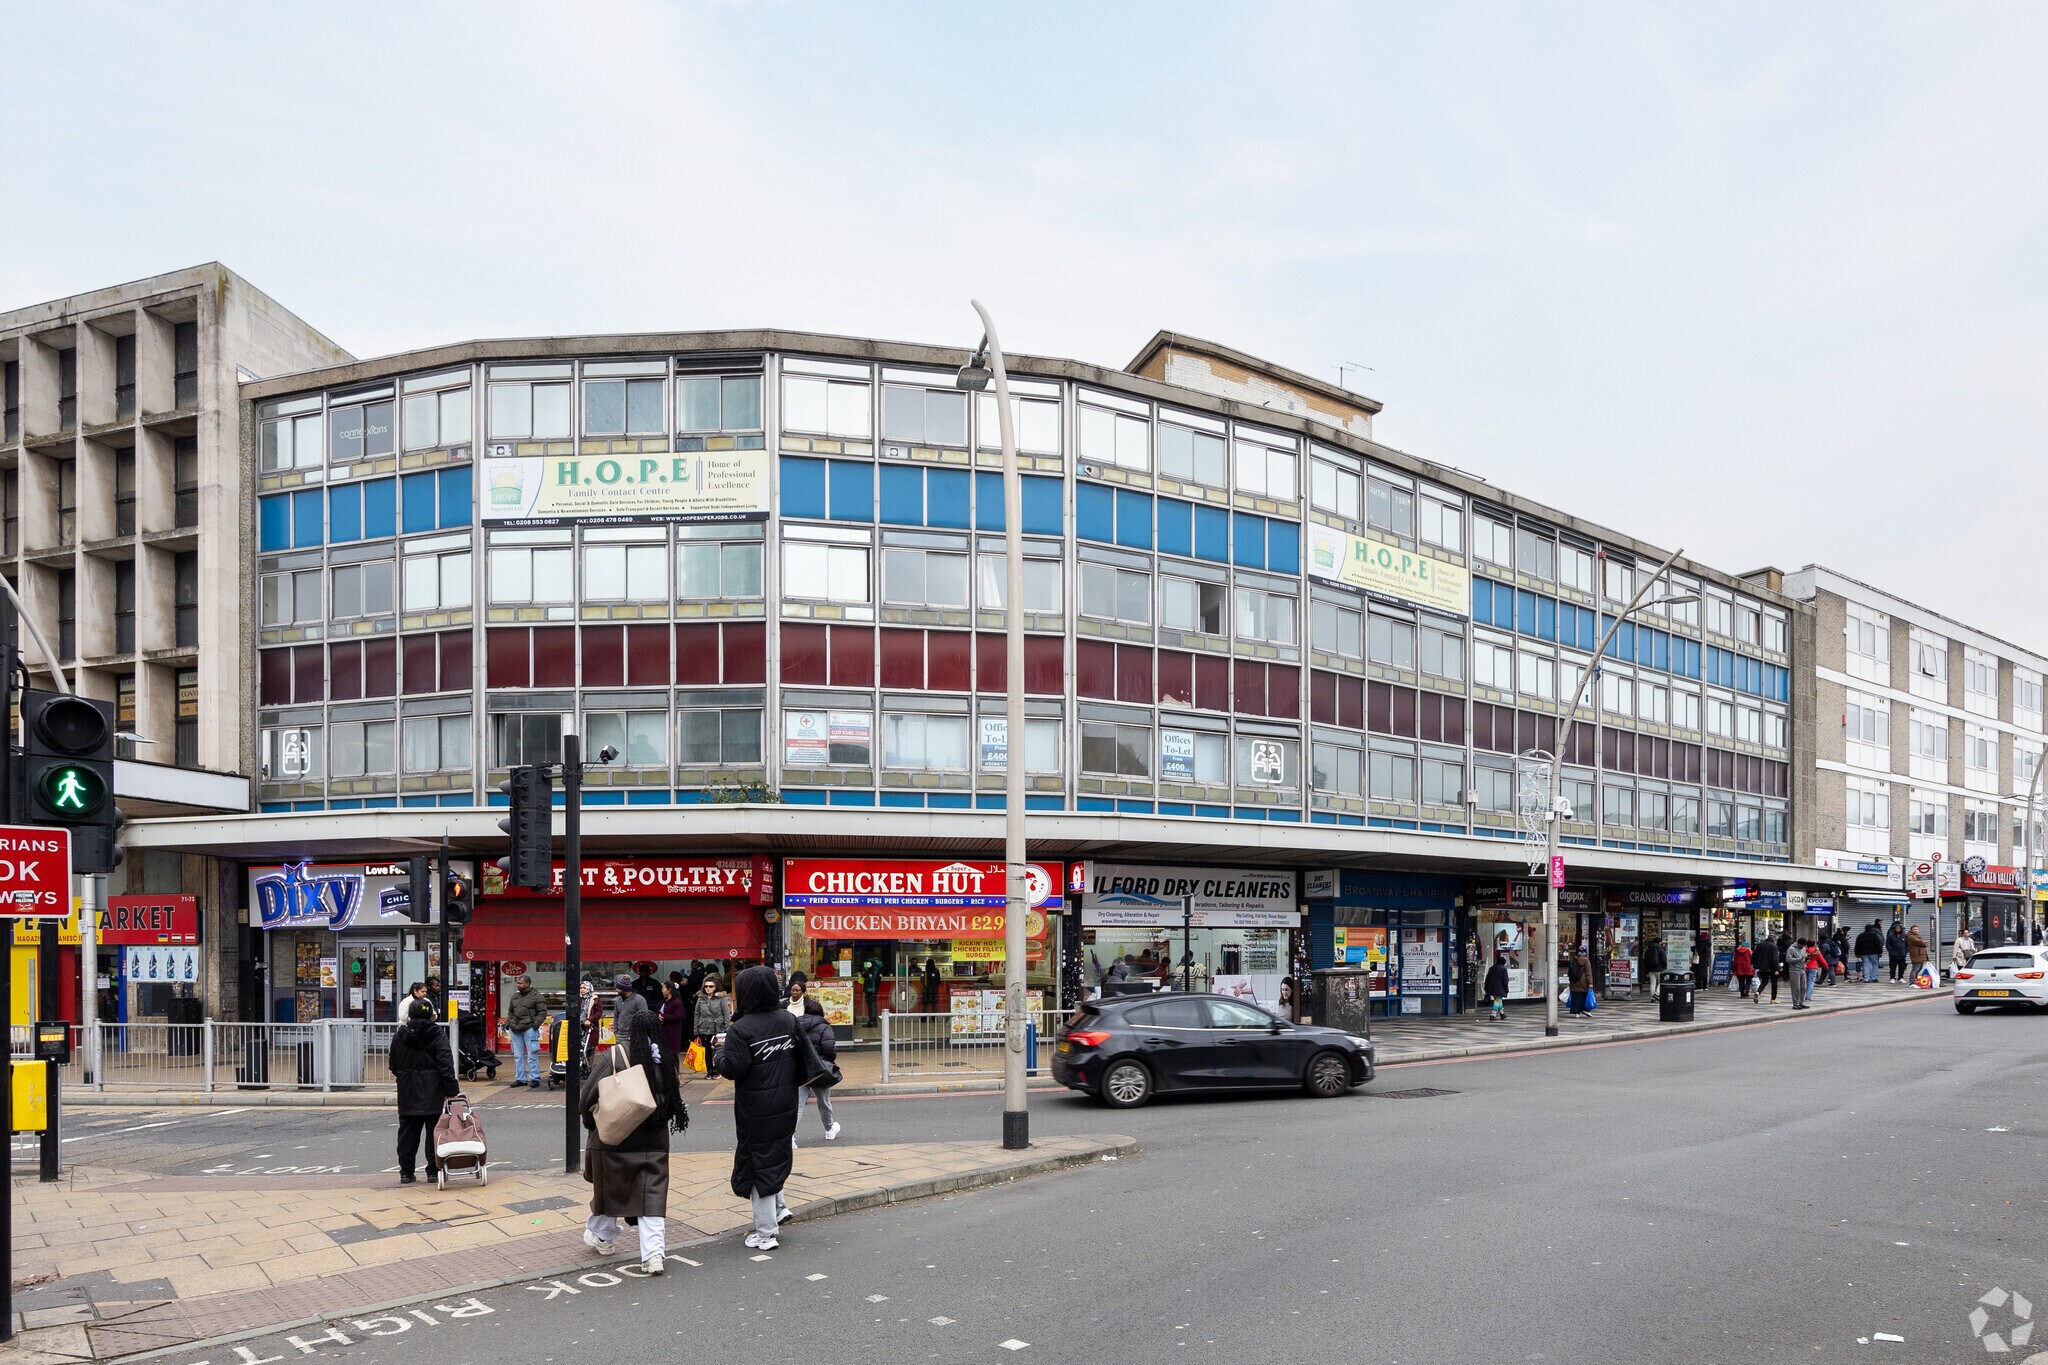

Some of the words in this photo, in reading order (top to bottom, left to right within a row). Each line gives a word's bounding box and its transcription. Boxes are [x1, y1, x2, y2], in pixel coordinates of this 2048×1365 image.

[707, 460, 731, 468] Home
[733, 459, 743, 467] of
[555, 457, 691, 486] H.O.P.E
[707, 470, 756, 479] Professional
[707, 481, 750, 490] Excellence
[568, 488, 598, 499] Family
[601, 487, 636, 497] Contact
[639, 487, 671, 495] Centre
[1354, 539, 1429, 580] H.O.P.E
[1164, 734, 1191, 745] Offices
[1165, 745, 1191, 755] To-Let
[987, 752, 1008, 760] £40
[365, 865, 389, 876] Love
[950, 865, 967, 873] Super
[603, 867, 619, 886] &
[623, 866, 738, 886] POULTRY
[1997, 872, 2015, 885] VALLEY
[808, 871, 923, 894] CHICKEN
[932, 872, 985, 894] HUT
[1092, 876, 1161, 896] ILFORD
[1162, 878, 1201, 897] DRY
[1203, 880, 1291, 899] CLEANERS
[1306, 881, 1332, 890] CLEANERS
[254, 861, 365, 931] Dixy
[1344, 885, 1399, 897] BROADWAY
[1476, 886, 1499, 896] digipix
[1559, 889, 1585, 902] digipix
[809, 897, 829, 905] FRIED
[1629, 891, 1684, 904] CRANBROOKS
[1218, 902, 1240, 910] Tailoring
[1097, 911, 1106, 919] Dry
[810, 914, 893, 931] CHICKEN
[897, 915, 967, 931] BIRYANI
[40, 1034, 64, 1042] WAIT
[234, 1165, 359, 1175] LOOK
